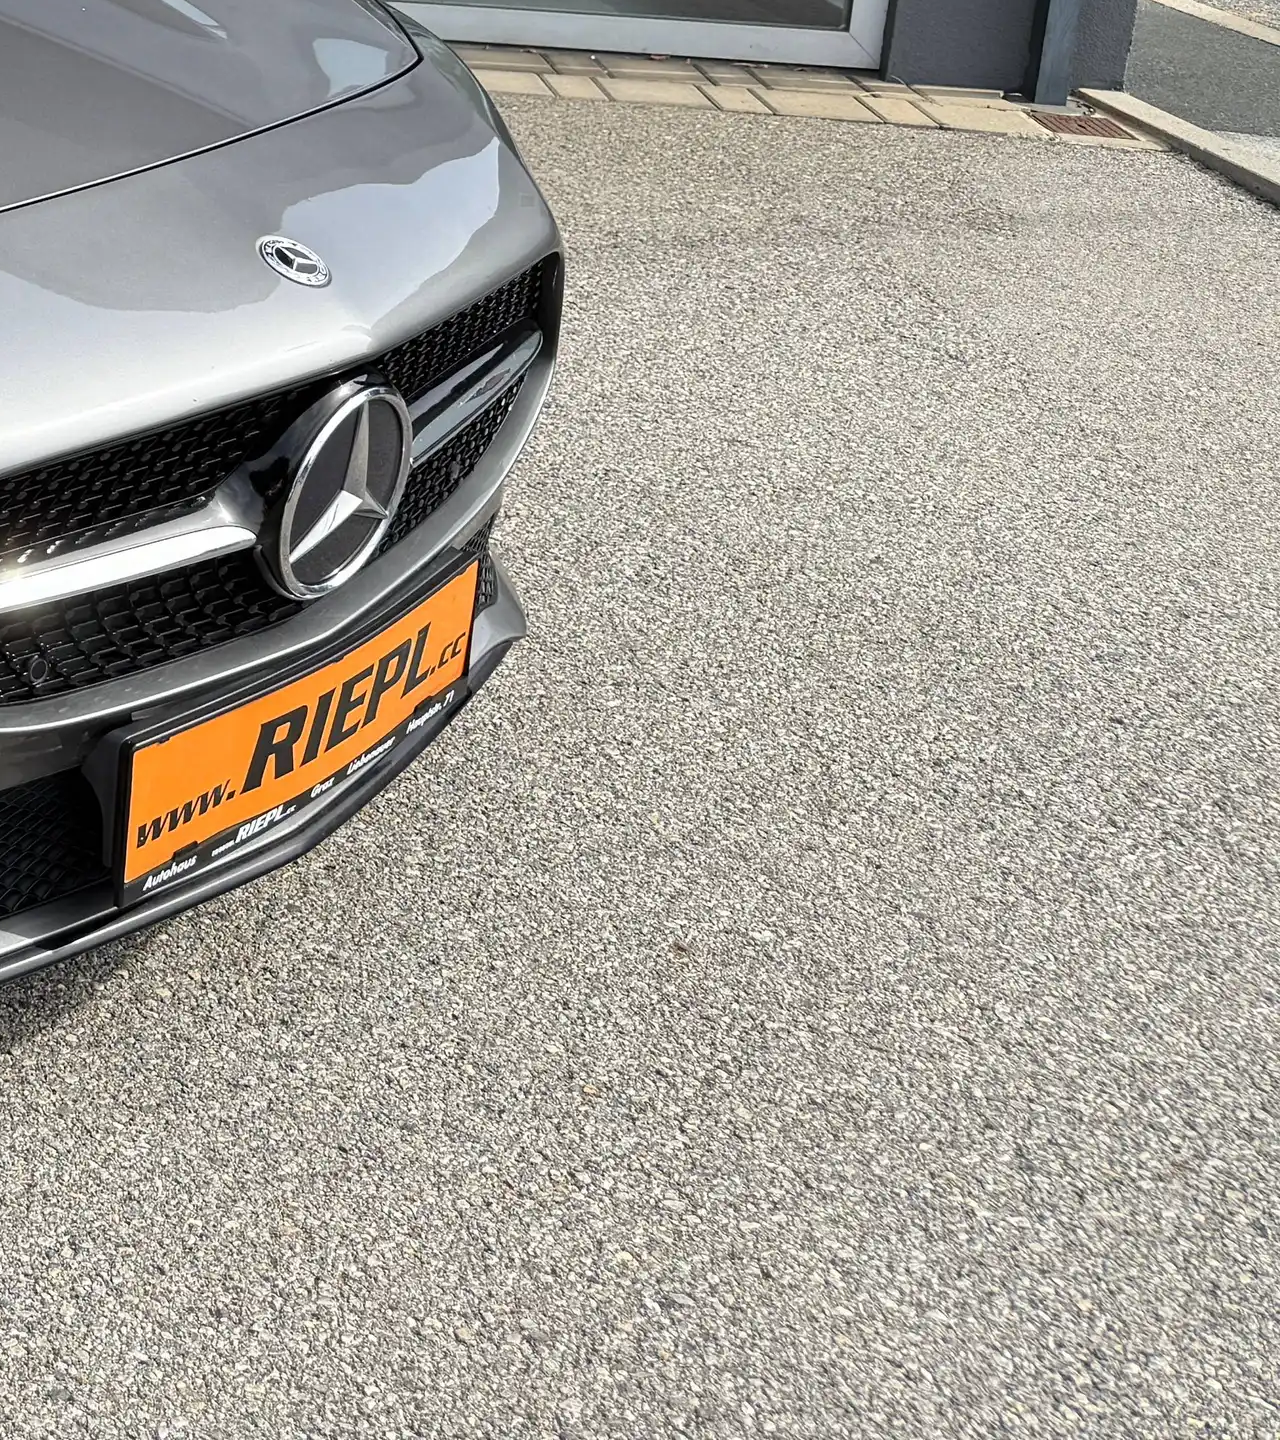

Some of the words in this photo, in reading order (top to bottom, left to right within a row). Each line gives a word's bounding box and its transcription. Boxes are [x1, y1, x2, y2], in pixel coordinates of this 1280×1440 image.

[137, 622, 466, 849] www.RIEPL.cc
[142, 855, 198, 891] Autohaus
[310, 776, 335, 798] Graz
